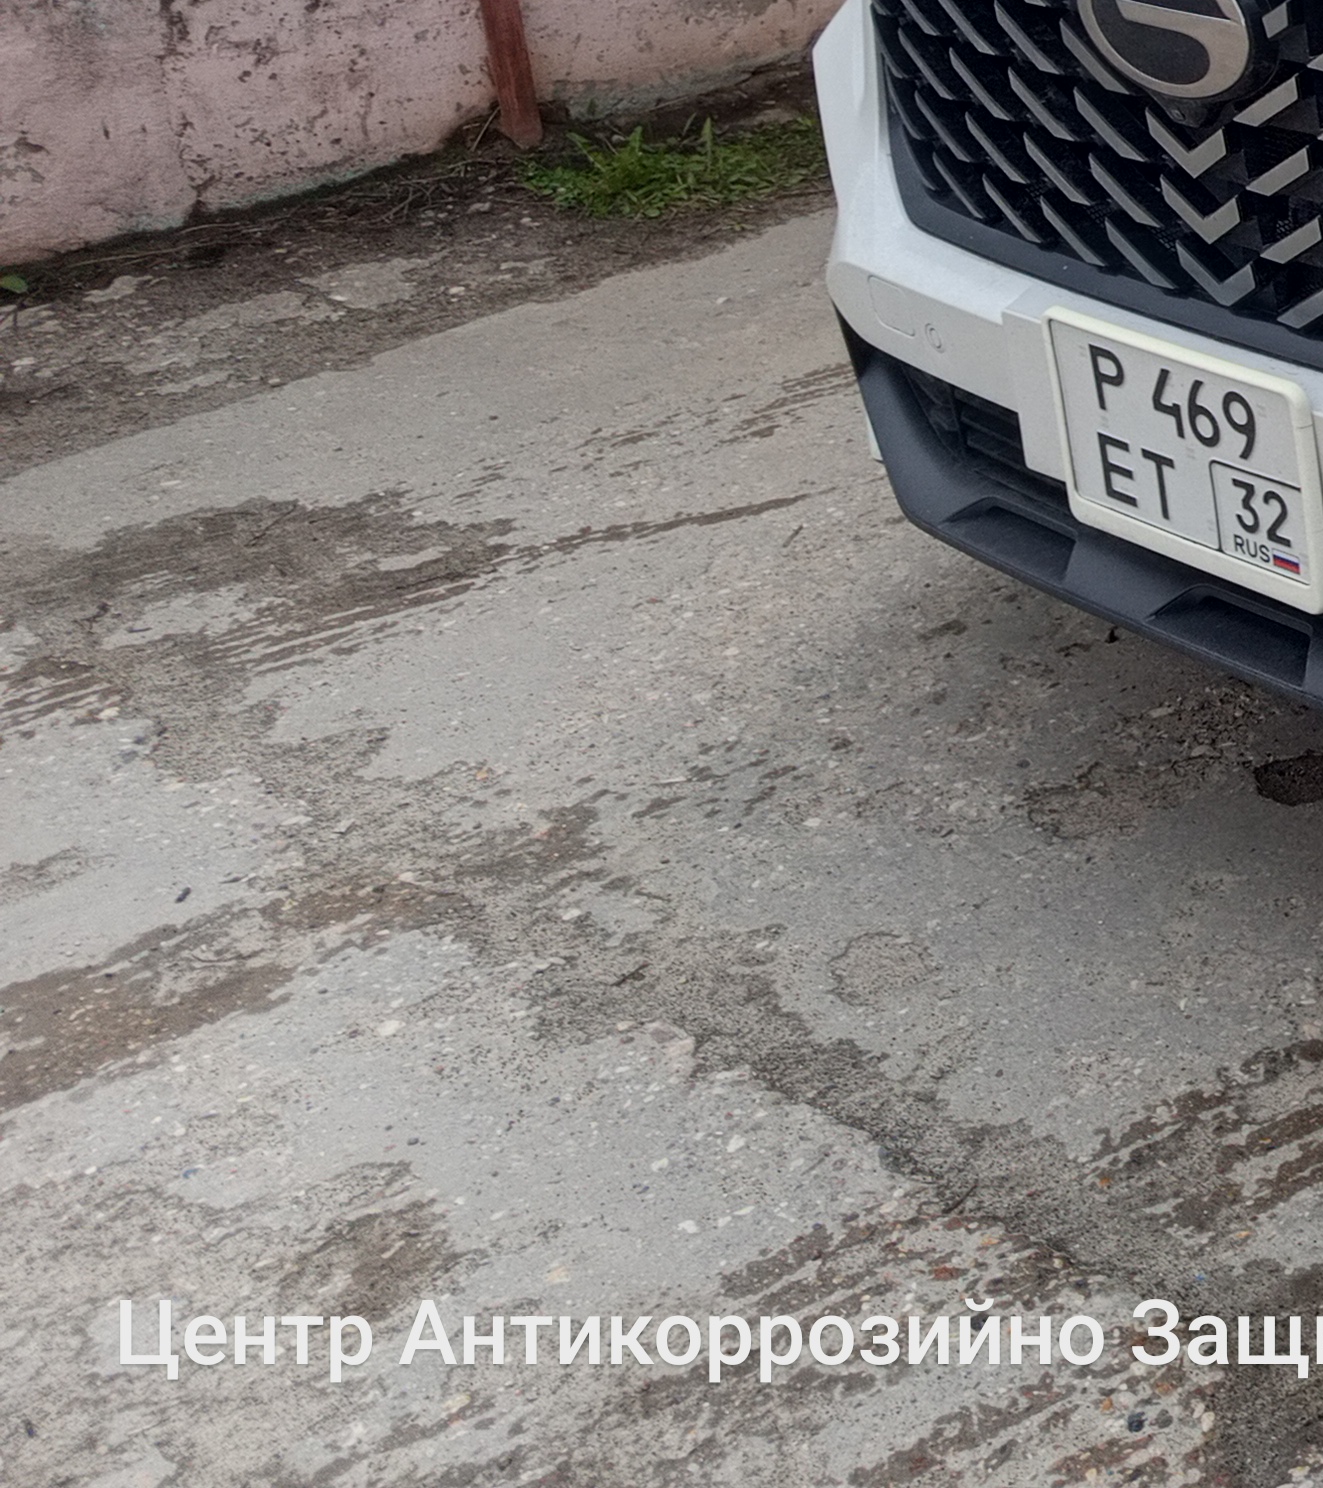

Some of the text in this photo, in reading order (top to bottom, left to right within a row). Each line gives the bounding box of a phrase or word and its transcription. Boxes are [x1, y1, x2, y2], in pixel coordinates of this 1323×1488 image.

[1151, 367, 1256, 461] 469
[1231, 477, 1292, 549] 32
[1233, 533, 1271, 564] RUS
